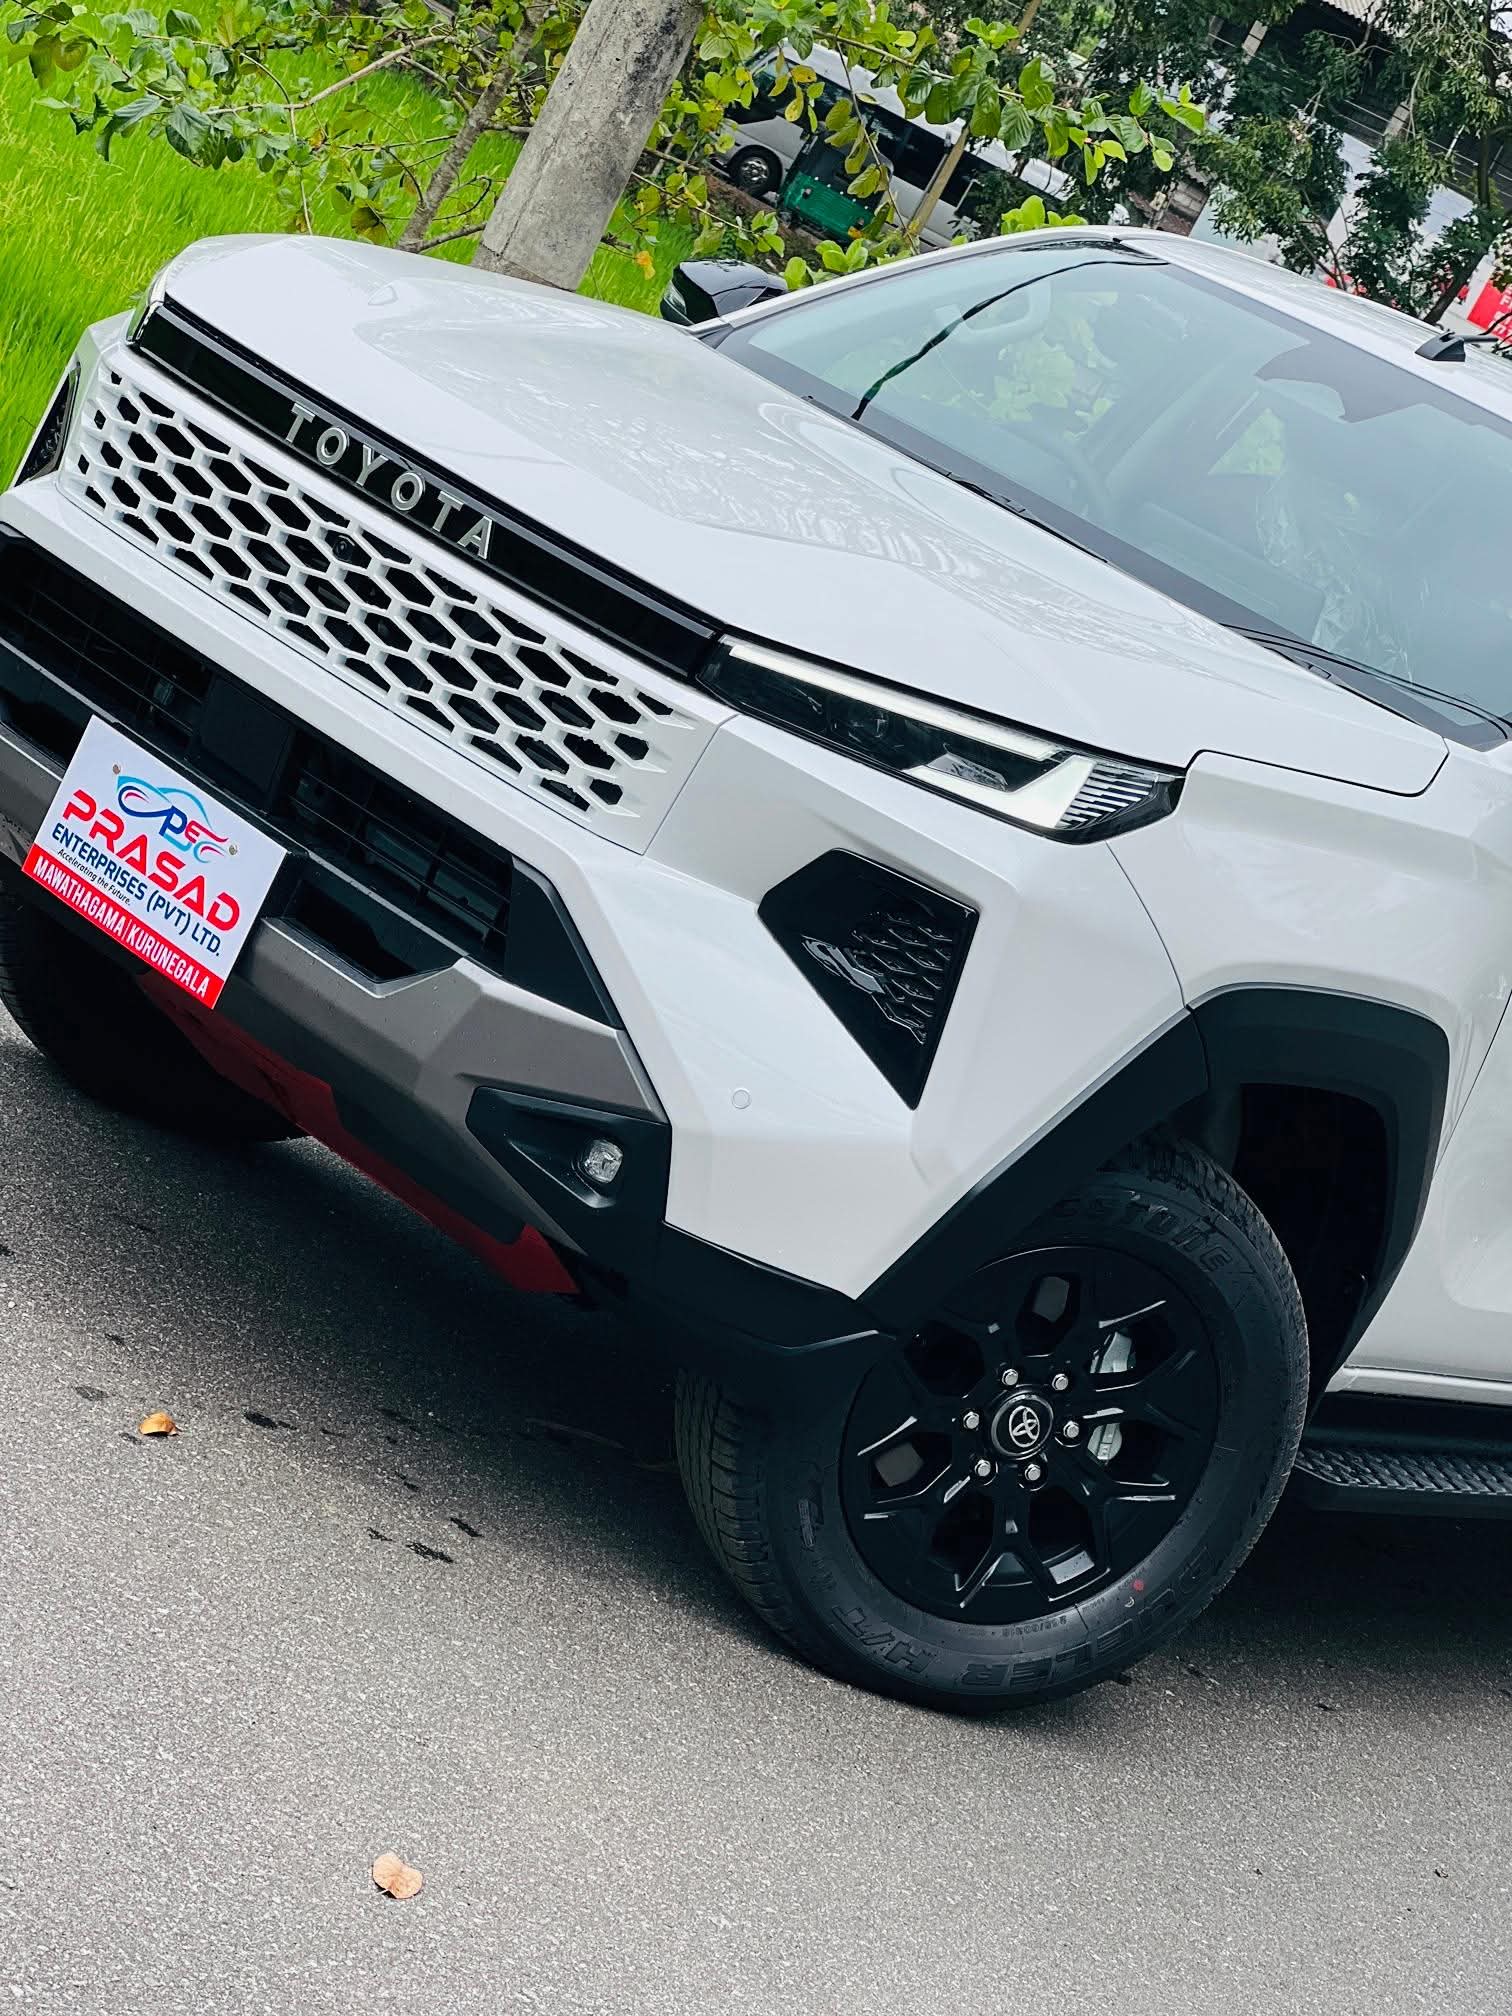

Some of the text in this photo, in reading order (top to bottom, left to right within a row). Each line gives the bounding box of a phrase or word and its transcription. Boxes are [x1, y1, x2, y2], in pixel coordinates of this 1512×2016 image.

[285, 402, 493, 560] TOYOTA
[52, 822, 222, 956] ENTERPRISES (PVT) LTD.
[57, 850, 131, 906] Accelerating the Future.
[63, 789, 240, 931] PRASAD
[128, 923, 209, 999] KURUNEGALA
